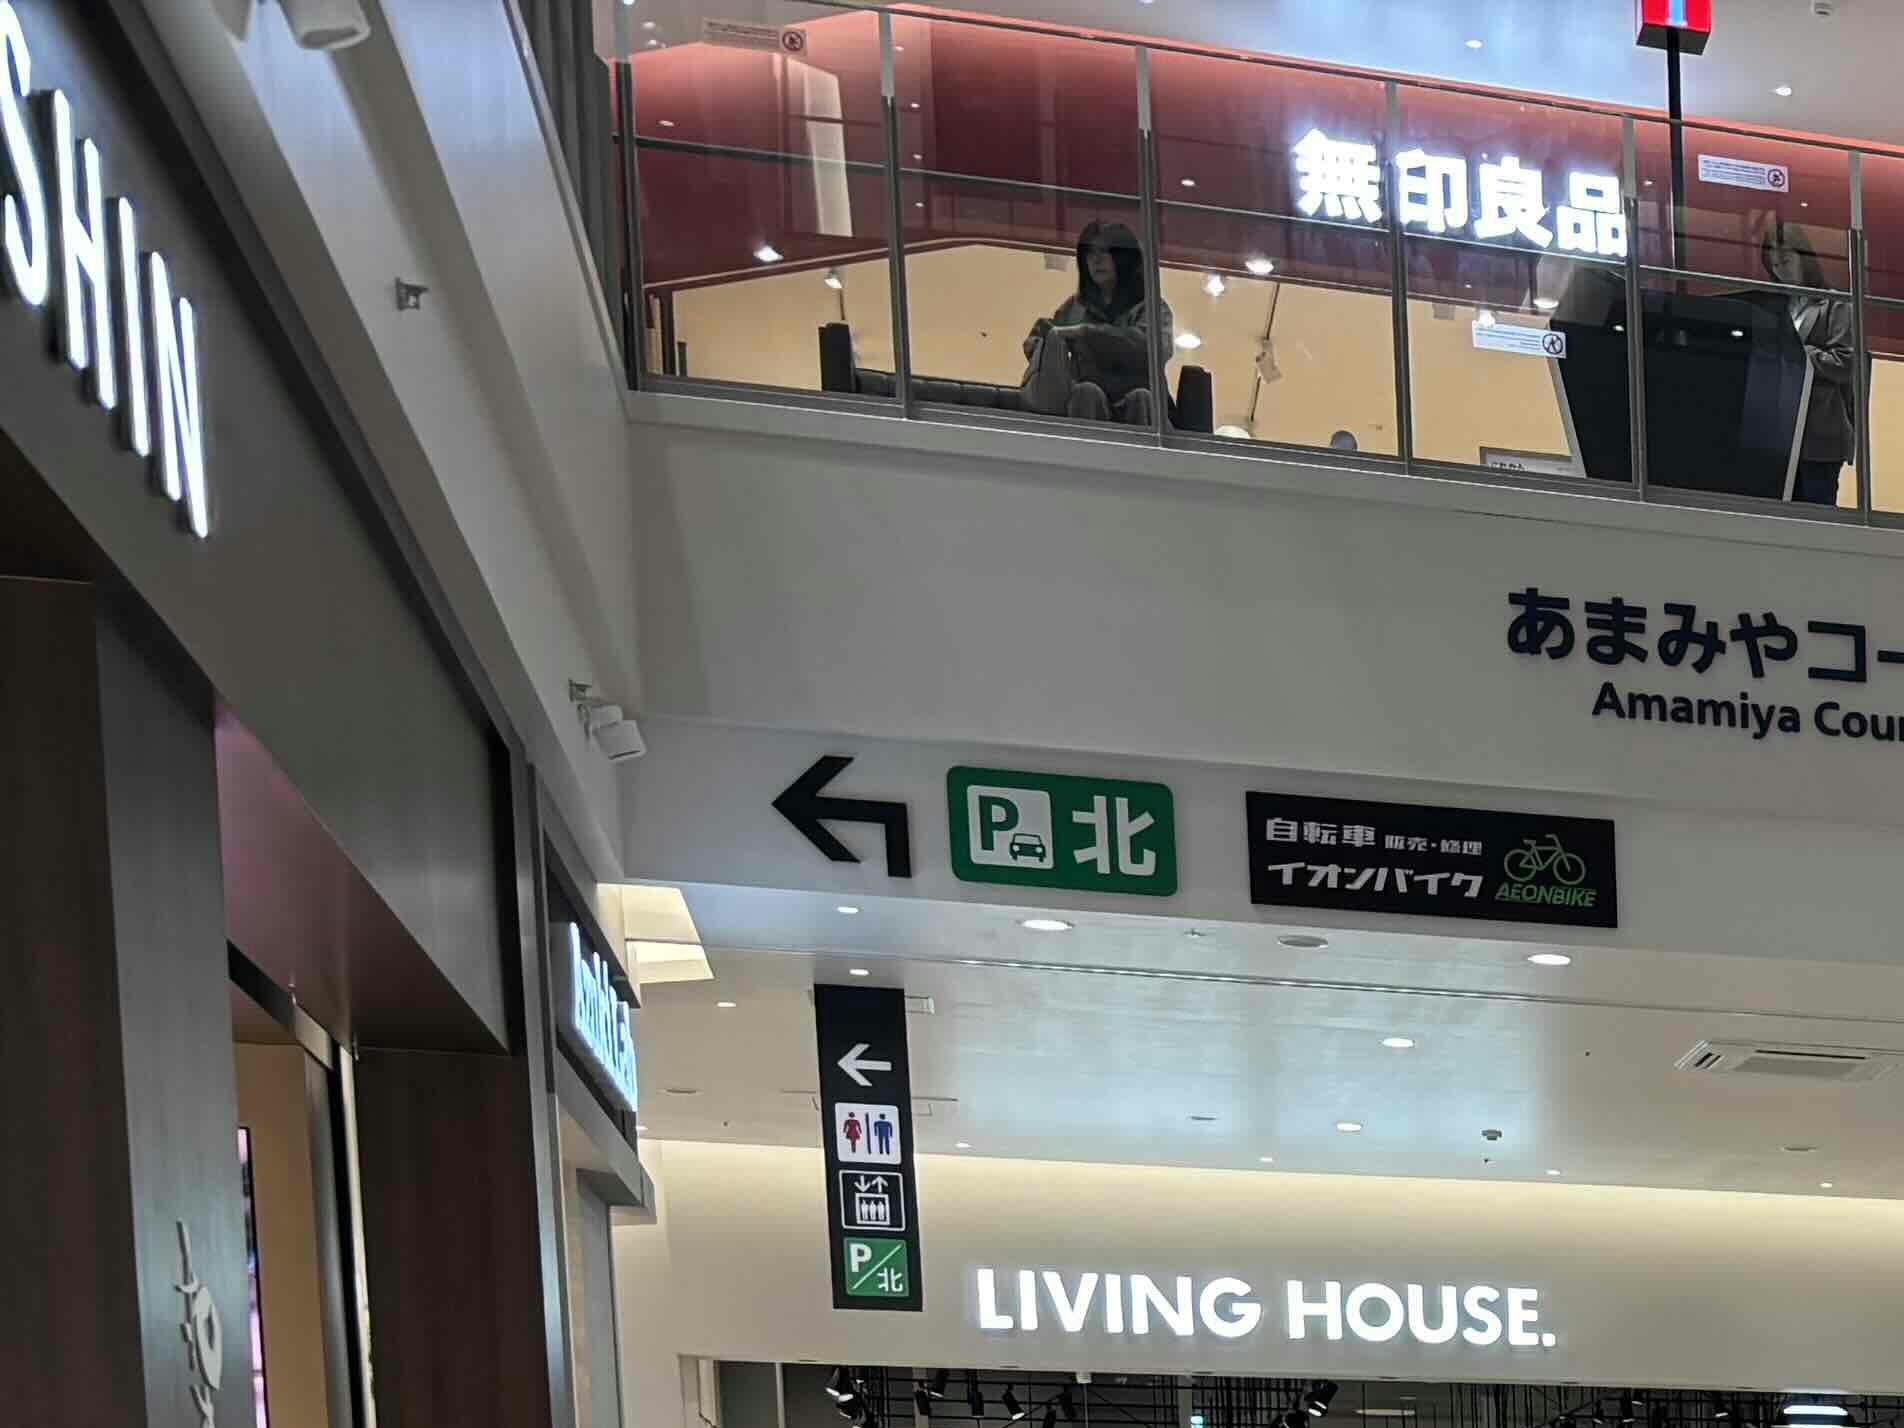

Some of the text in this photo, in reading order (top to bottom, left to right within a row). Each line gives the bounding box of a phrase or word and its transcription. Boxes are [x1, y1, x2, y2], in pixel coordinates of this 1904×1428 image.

[1294, 127, 1628, 258] 無印良品
[0, 0, 208, 540] SHIN
[1592, 681, 1800, 740] Amamiya
[1071, 795, 1157, 876] 北
[1265, 817, 1376, 847] 自転車
[1267, 861, 1484, 898] イオンバイク
[1495, 882, 1597, 908] AEONBIKE
[849, 1243, 872, 1273] P
[876, 1266, 903, 1292] 北
[976, 1268, 1557, 1347] LIVING HOUSE.
